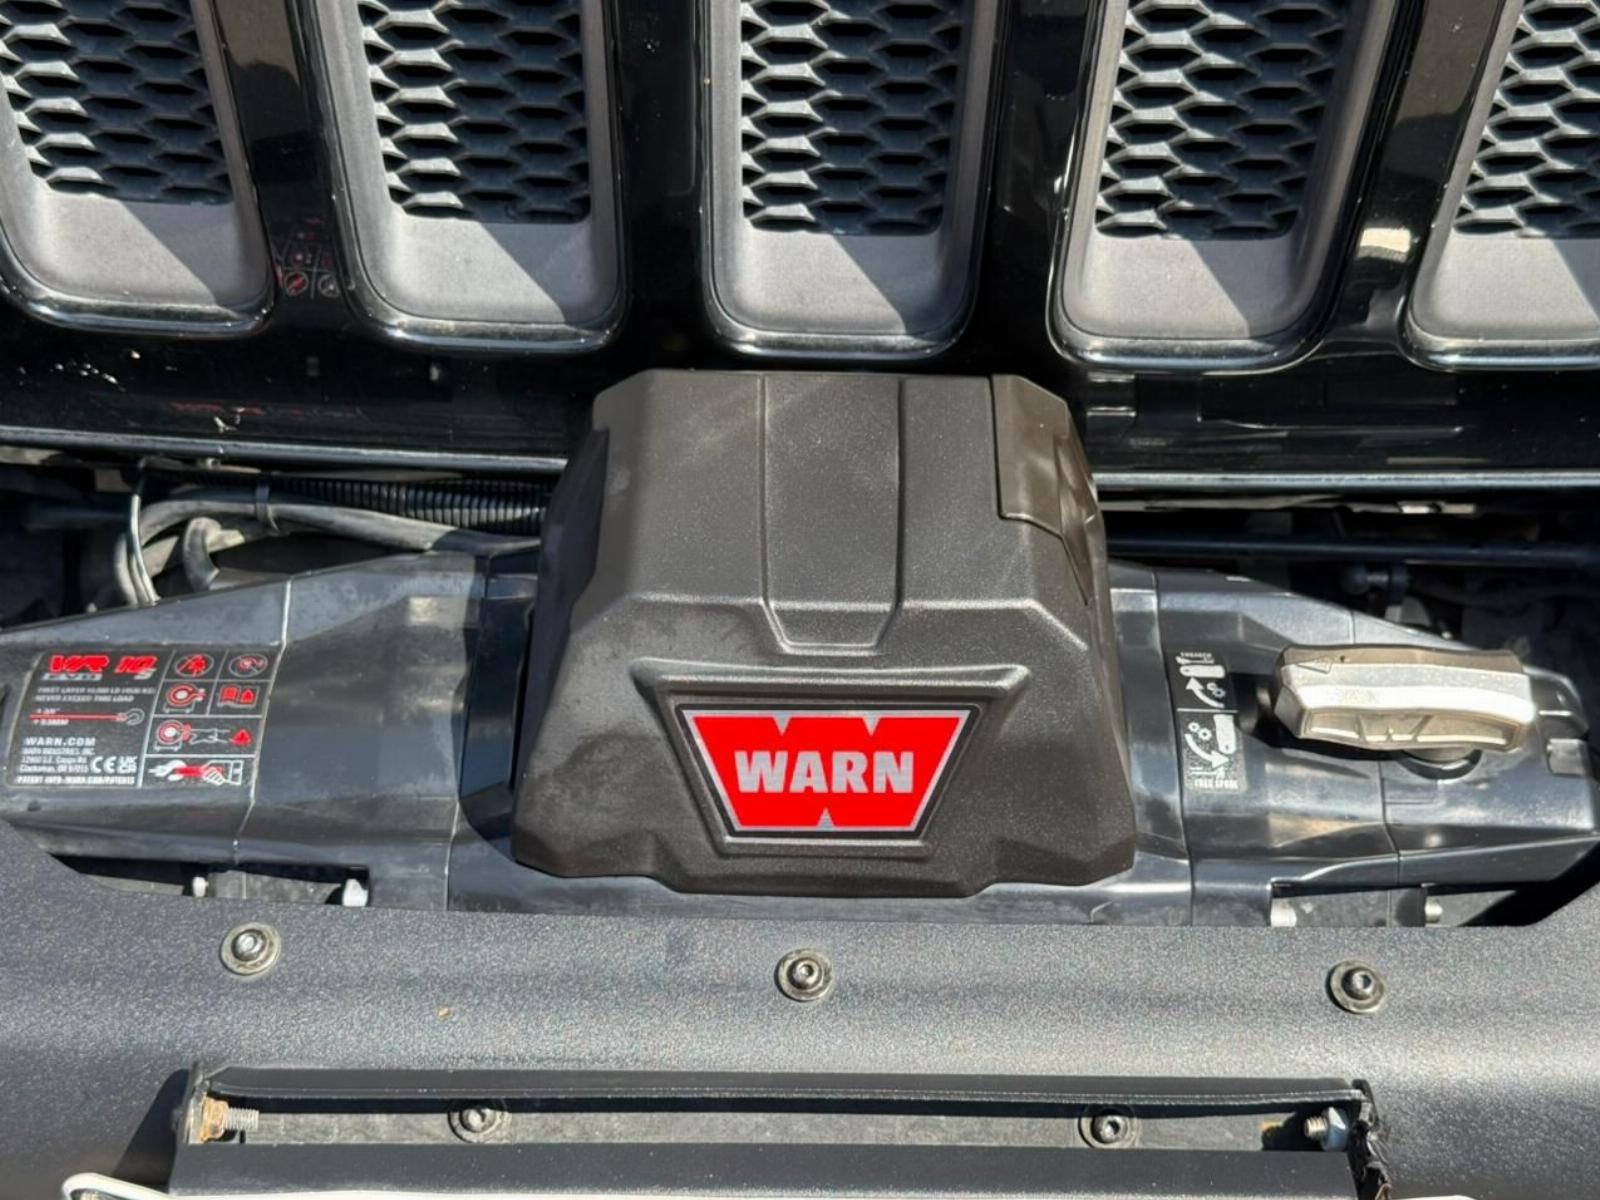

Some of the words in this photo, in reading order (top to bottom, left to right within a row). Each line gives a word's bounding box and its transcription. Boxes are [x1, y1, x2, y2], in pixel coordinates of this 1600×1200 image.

[24, 737, 96, 746] WARN.COM
[90, 756, 118, 773] CE
[734, 751, 914, 793] WARN
